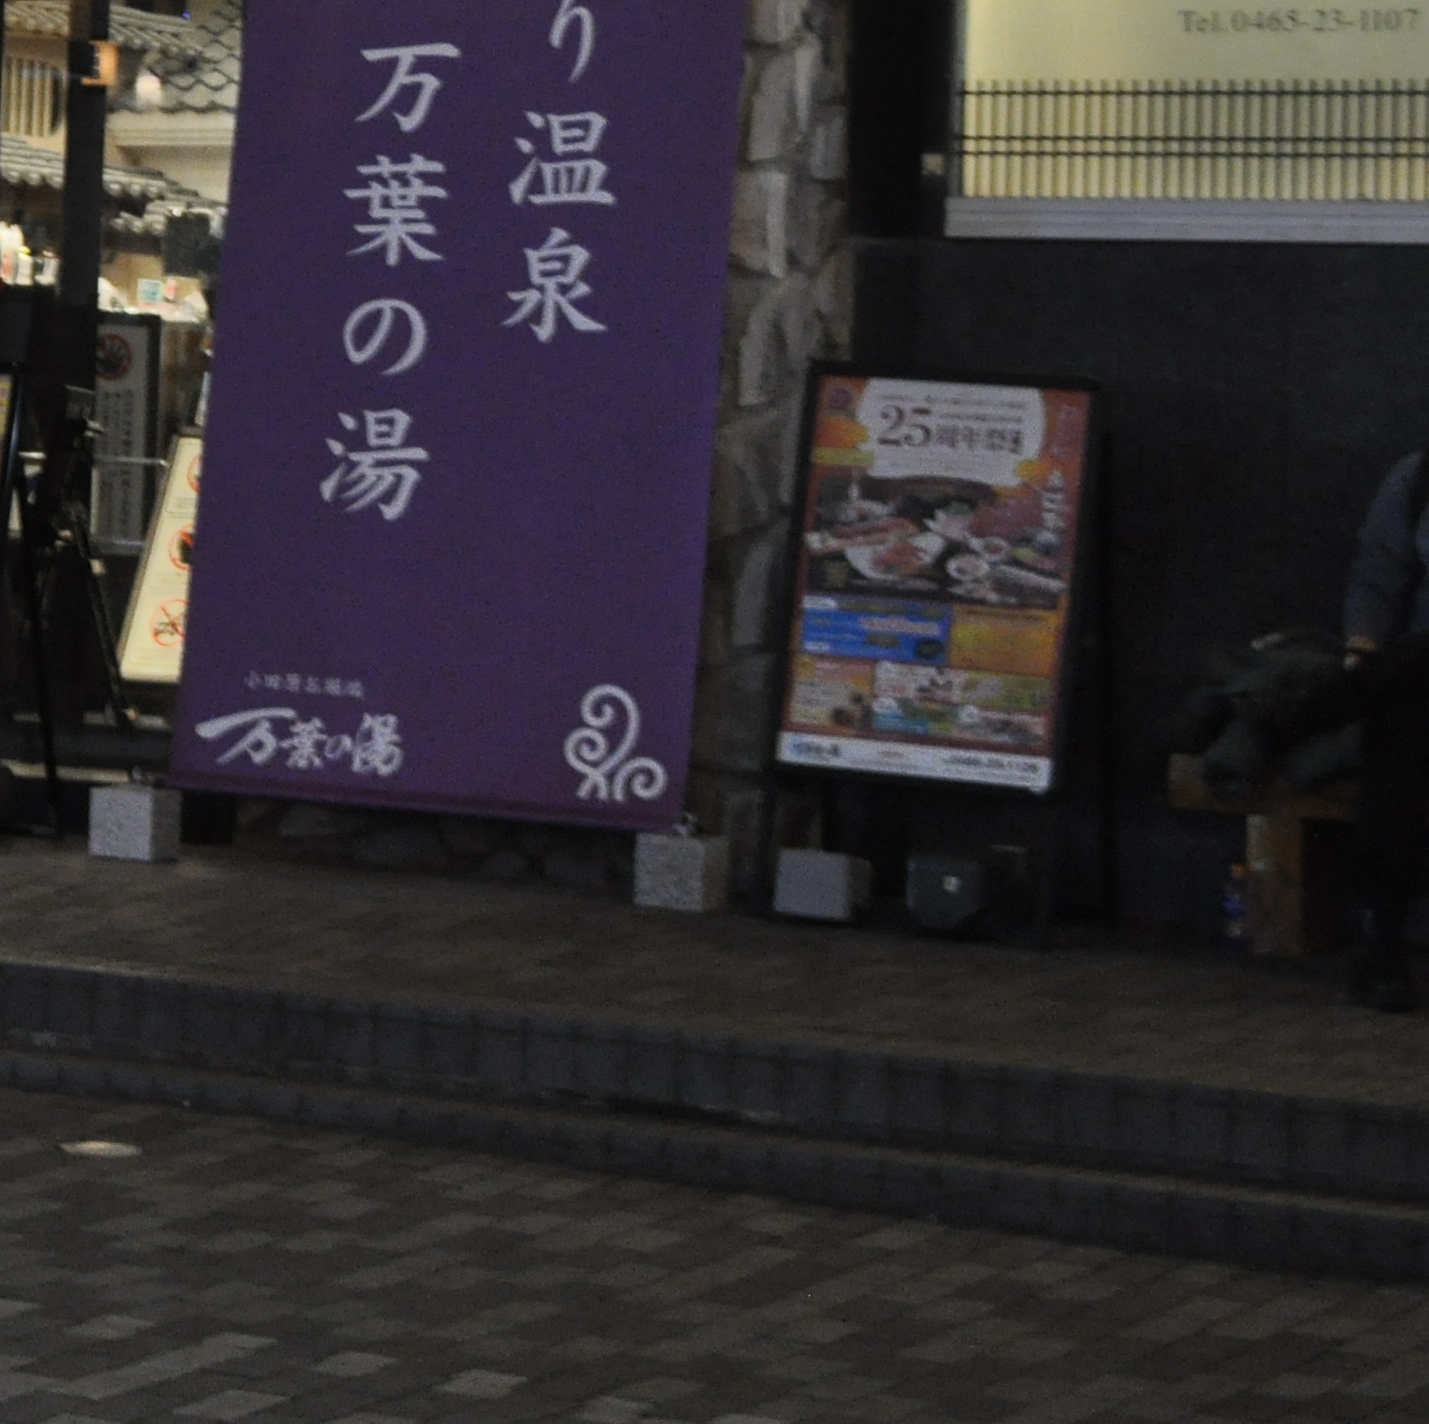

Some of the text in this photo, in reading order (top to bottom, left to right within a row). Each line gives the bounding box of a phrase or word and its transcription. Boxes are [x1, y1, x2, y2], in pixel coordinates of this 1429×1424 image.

[320, 43, 461, 521] 万葉の湯
[195, 707, 404, 775] 万葉の湯
